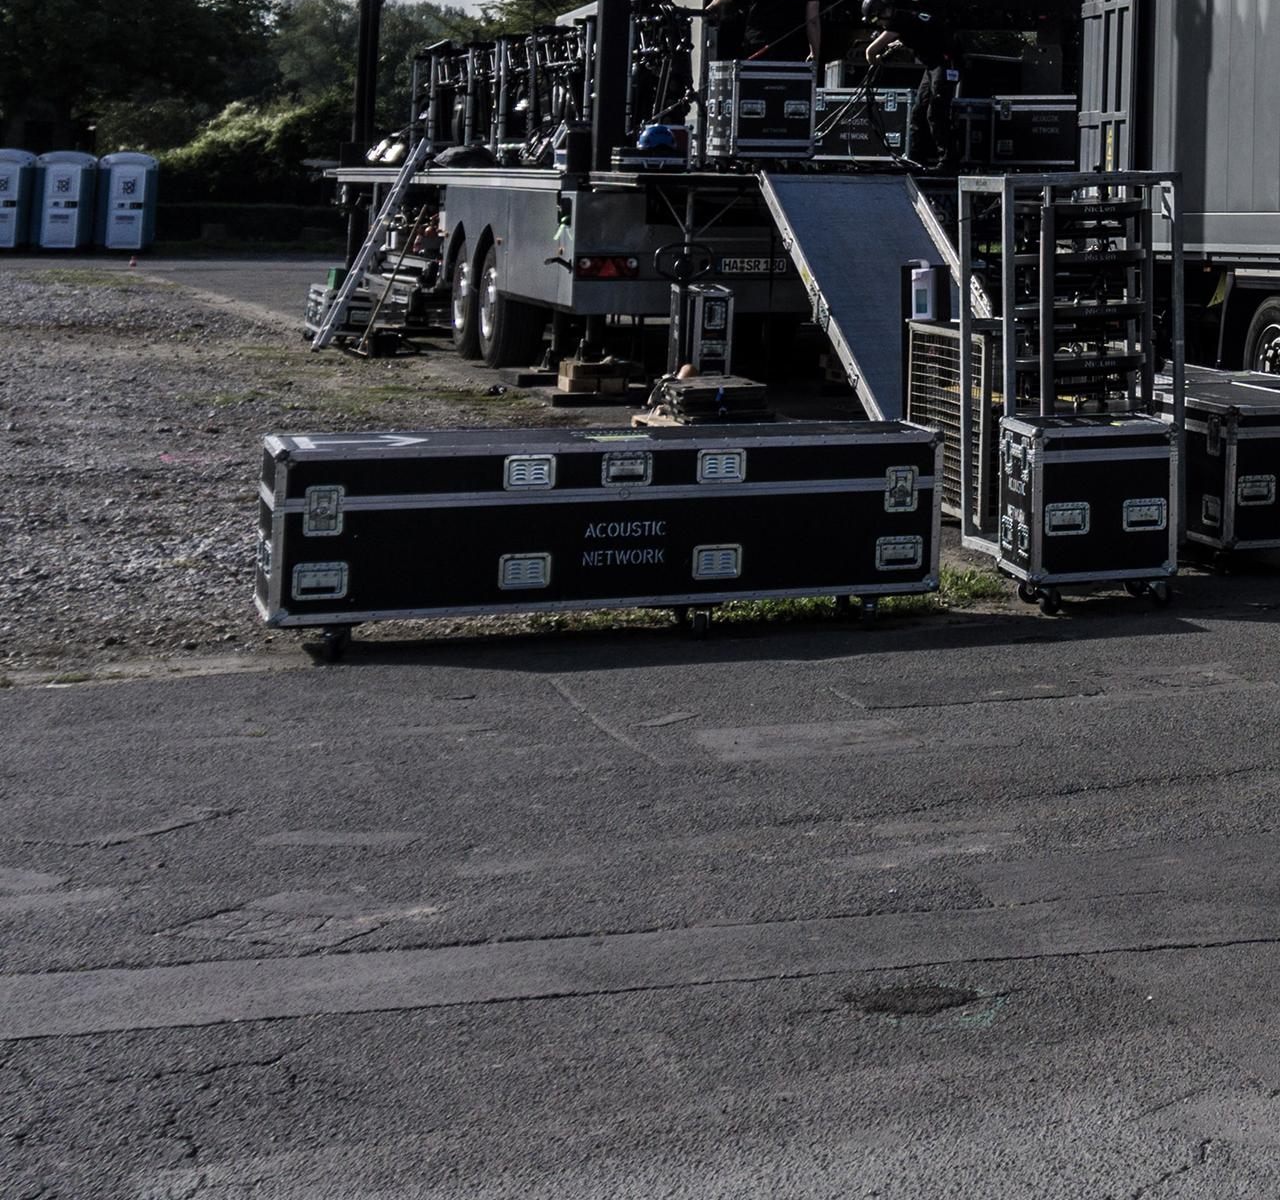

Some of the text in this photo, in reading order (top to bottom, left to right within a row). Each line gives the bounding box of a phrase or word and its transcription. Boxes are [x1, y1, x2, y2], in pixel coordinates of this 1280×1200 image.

[839, 132, 870, 141] NETWORK
[723, 260, 740, 271] HA
[746, 260, 760, 271] SR
[584, 520, 667, 539] ACOUSTIC
[582, 548, 665, 567] NETWORK
